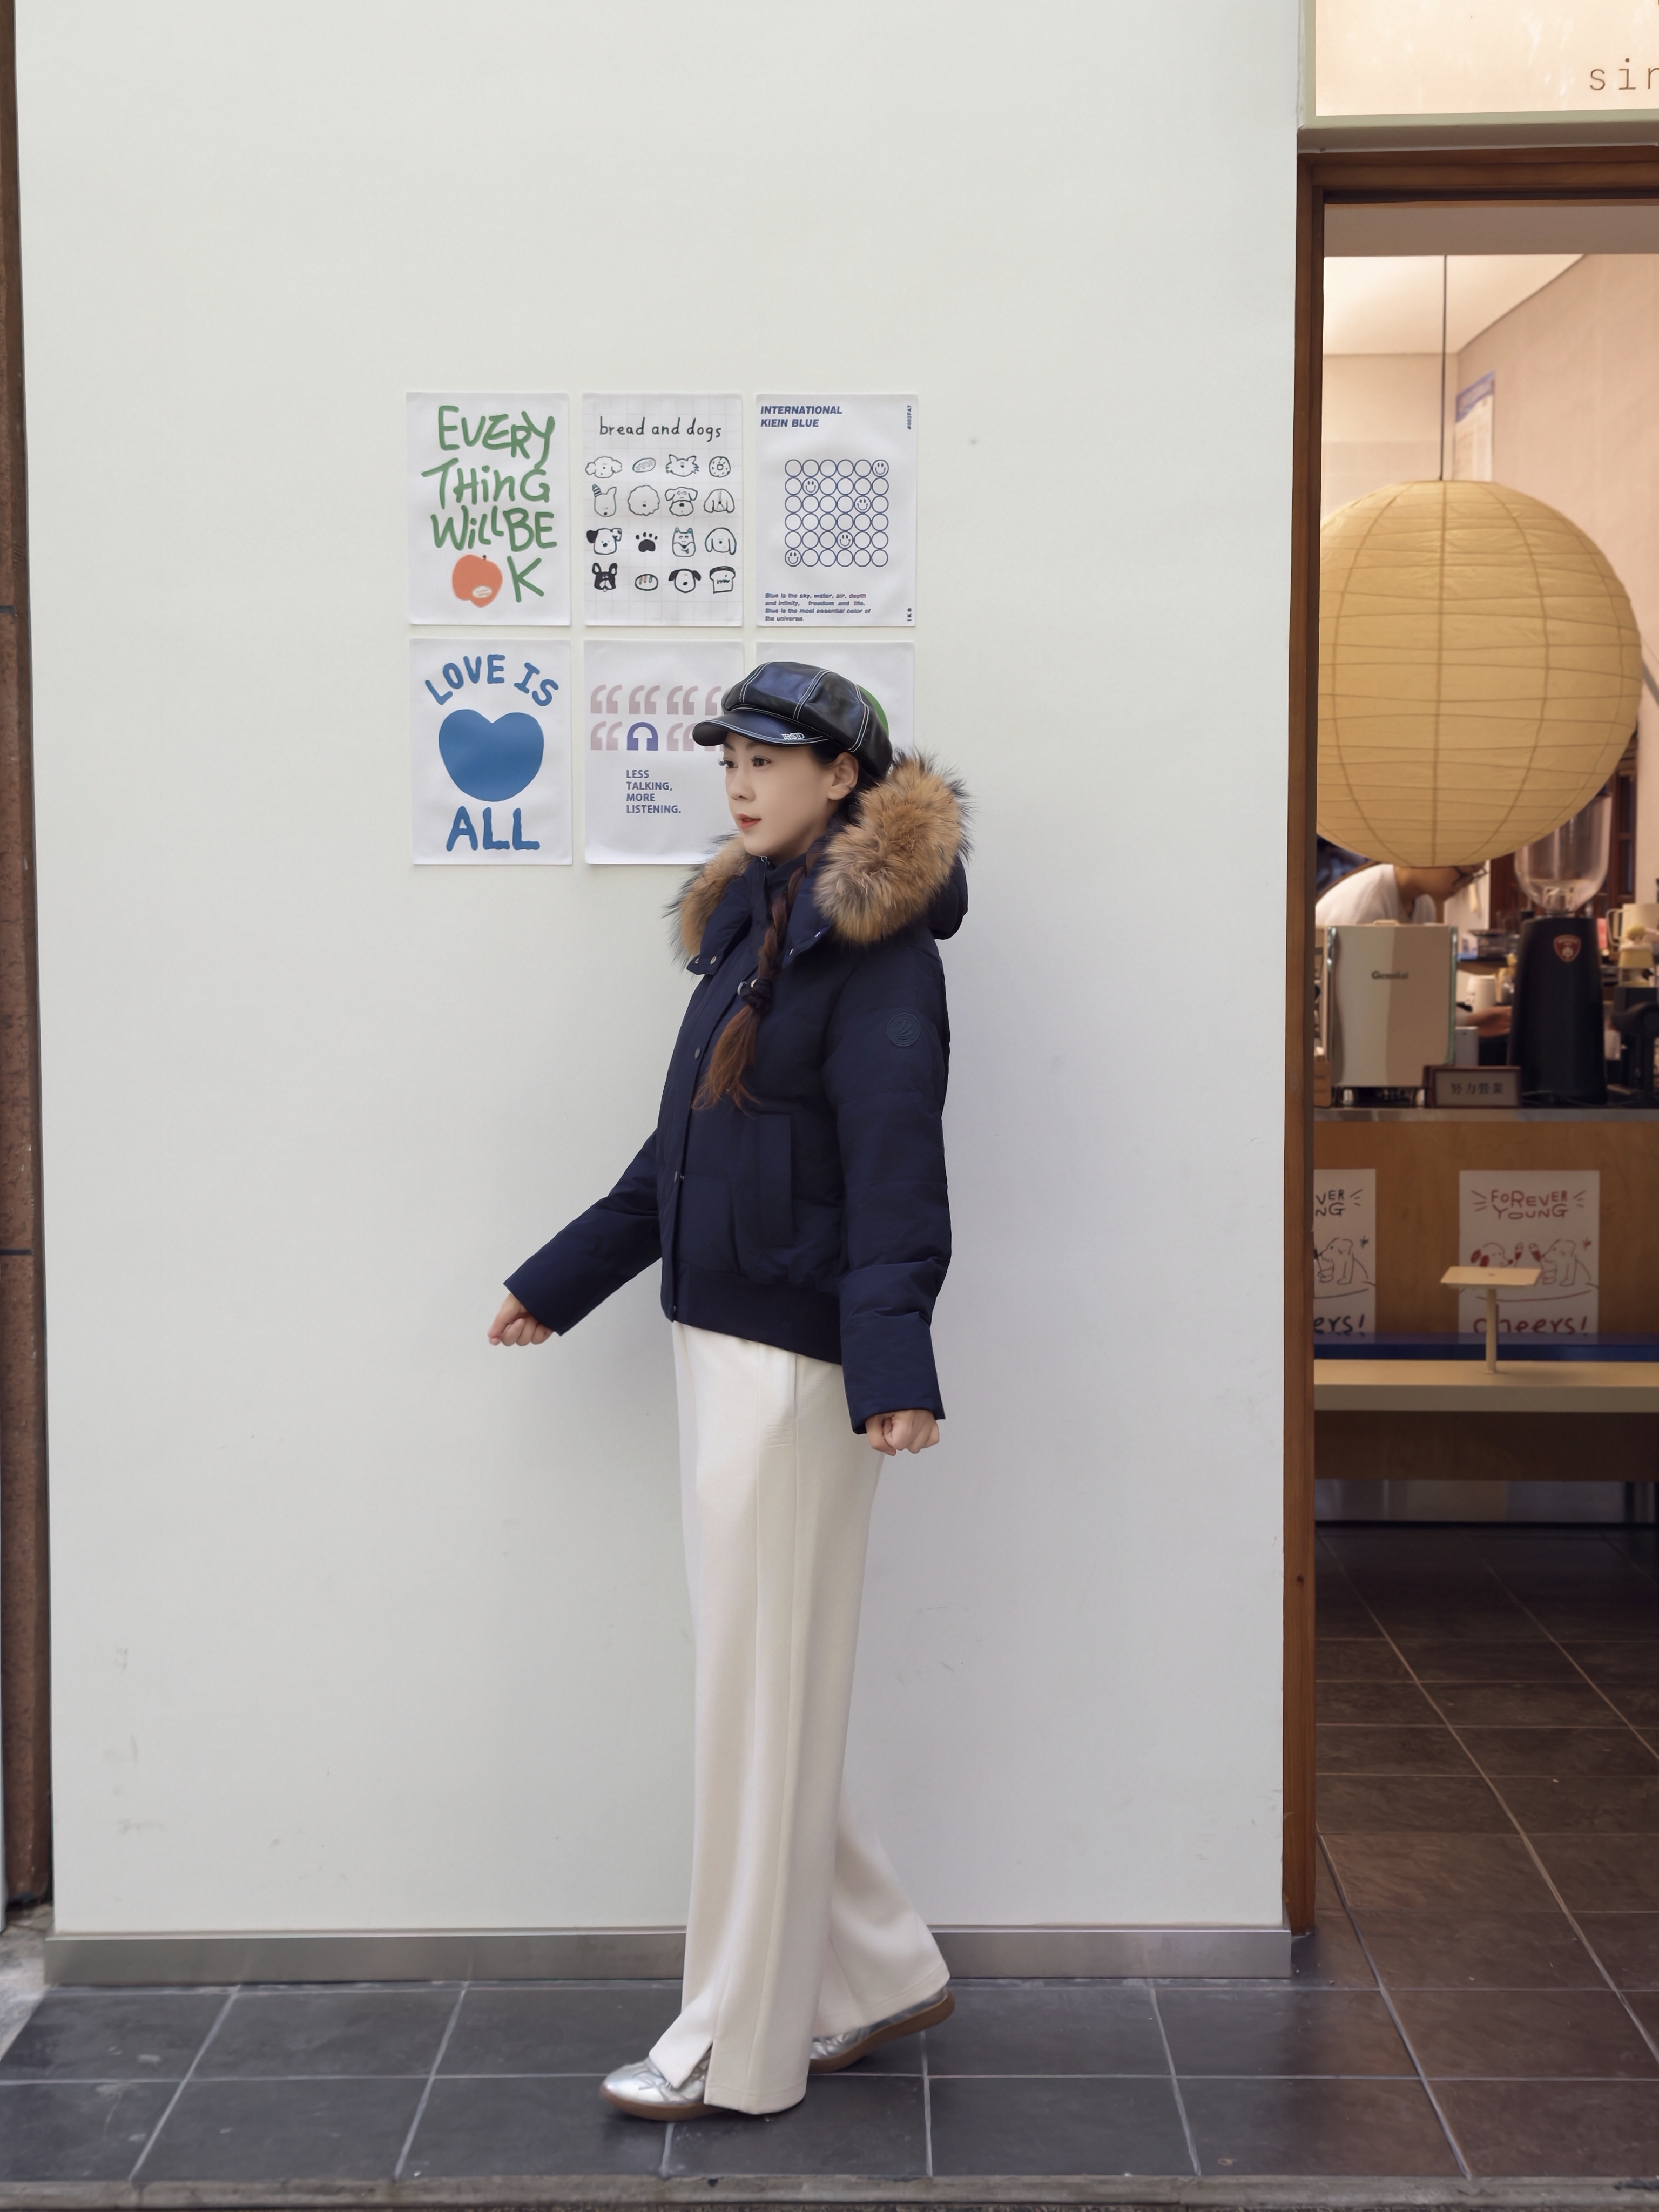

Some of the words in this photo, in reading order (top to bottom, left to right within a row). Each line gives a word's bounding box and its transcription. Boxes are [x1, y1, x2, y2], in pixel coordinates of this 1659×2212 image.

[761, 406, 842, 414] INTERNATIONAL
[599, 416, 645, 435] bread
[652, 417, 680, 435] and
[686, 417, 721, 442] dogs
[792, 419, 819, 427] BLUE
[438, 405, 555, 469] EVERY
[503, 508, 558, 552] BE
[425, 654, 505, 705] LOVE
[514, 662, 559, 706] IS
[626, 770, 649, 778] LESS
[626, 781, 672, 791] TALKING,
[626, 793, 655, 801] MORE
[626, 805, 681, 813] LISTENING.
[446, 806, 540, 852] ALL
[1492, 1203, 1569, 1220] YOUNG
